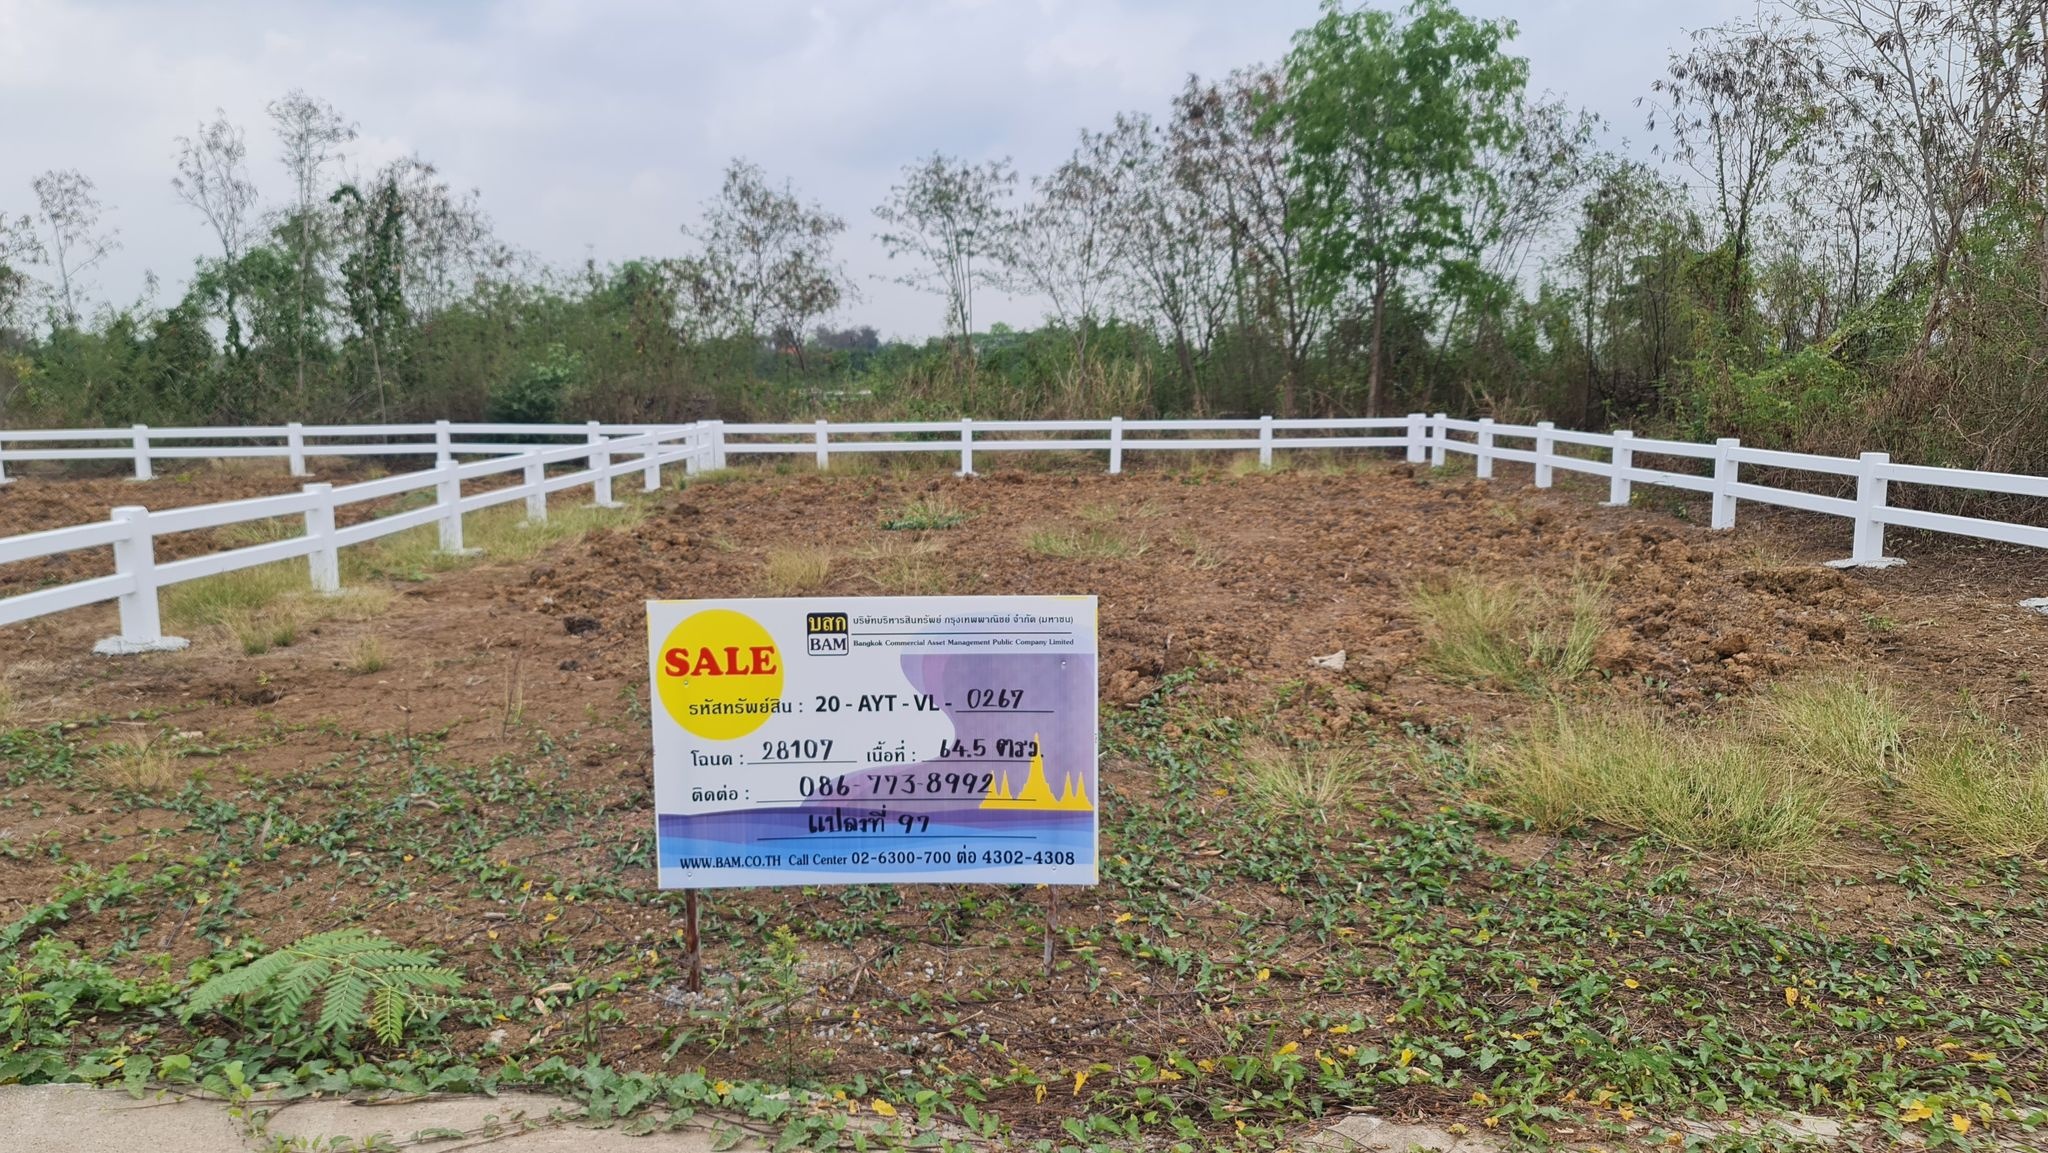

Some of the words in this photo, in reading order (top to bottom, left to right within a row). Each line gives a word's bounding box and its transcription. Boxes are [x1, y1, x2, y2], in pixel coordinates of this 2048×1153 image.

[808, 615, 847, 633] บสก
[853, 614, 942, 625] บริษัทบริหารสินทรัพย์
[944, 614, 1010, 627] กรุงเทพพาณิชย์
[1013, 614, 1036, 625] จำกัด
[1038, 614, 1074, 625] (มหาชน)
[810, 637, 847, 651] BAM
[853, 640, 883, 649] Bangkok
[947, 639, 990, 648] Management
[1015, 639, 1047, 648] Company
[1049, 638, 1074, 646] Limited
[665, 646, 777, 677] SALE
[689, 698, 792, 716] รหัสทรัพย์สิน
[815, 696, 840, 713] 20
[858, 695, 897, 711] AYT
[914, 695, 940, 711] VL
[967, 688, 1024, 709] 0267
[691, 750, 733, 767] โฉนด
[762, 739, 833, 761] 28107
[867, 740, 905, 762] เนื้อที่
[940, 738, 986, 758] 64.5
[692, 784, 738, 802] ติดต่อ
[800, 772, 993, 797] 086-773-8992
[808, 804, 886, 833] แปลงที่
[898, 814, 930, 834] 97
[680, 855, 781, 870] WWW.BAM.CO.TH
[788, 854, 809, 866] Call
[812, 854, 847, 865] Center
[851, 851, 951, 865] 02-6300-700
[957, 844, 977, 865] ต่อ
[982, 850, 1075, 865] 4302-4308
